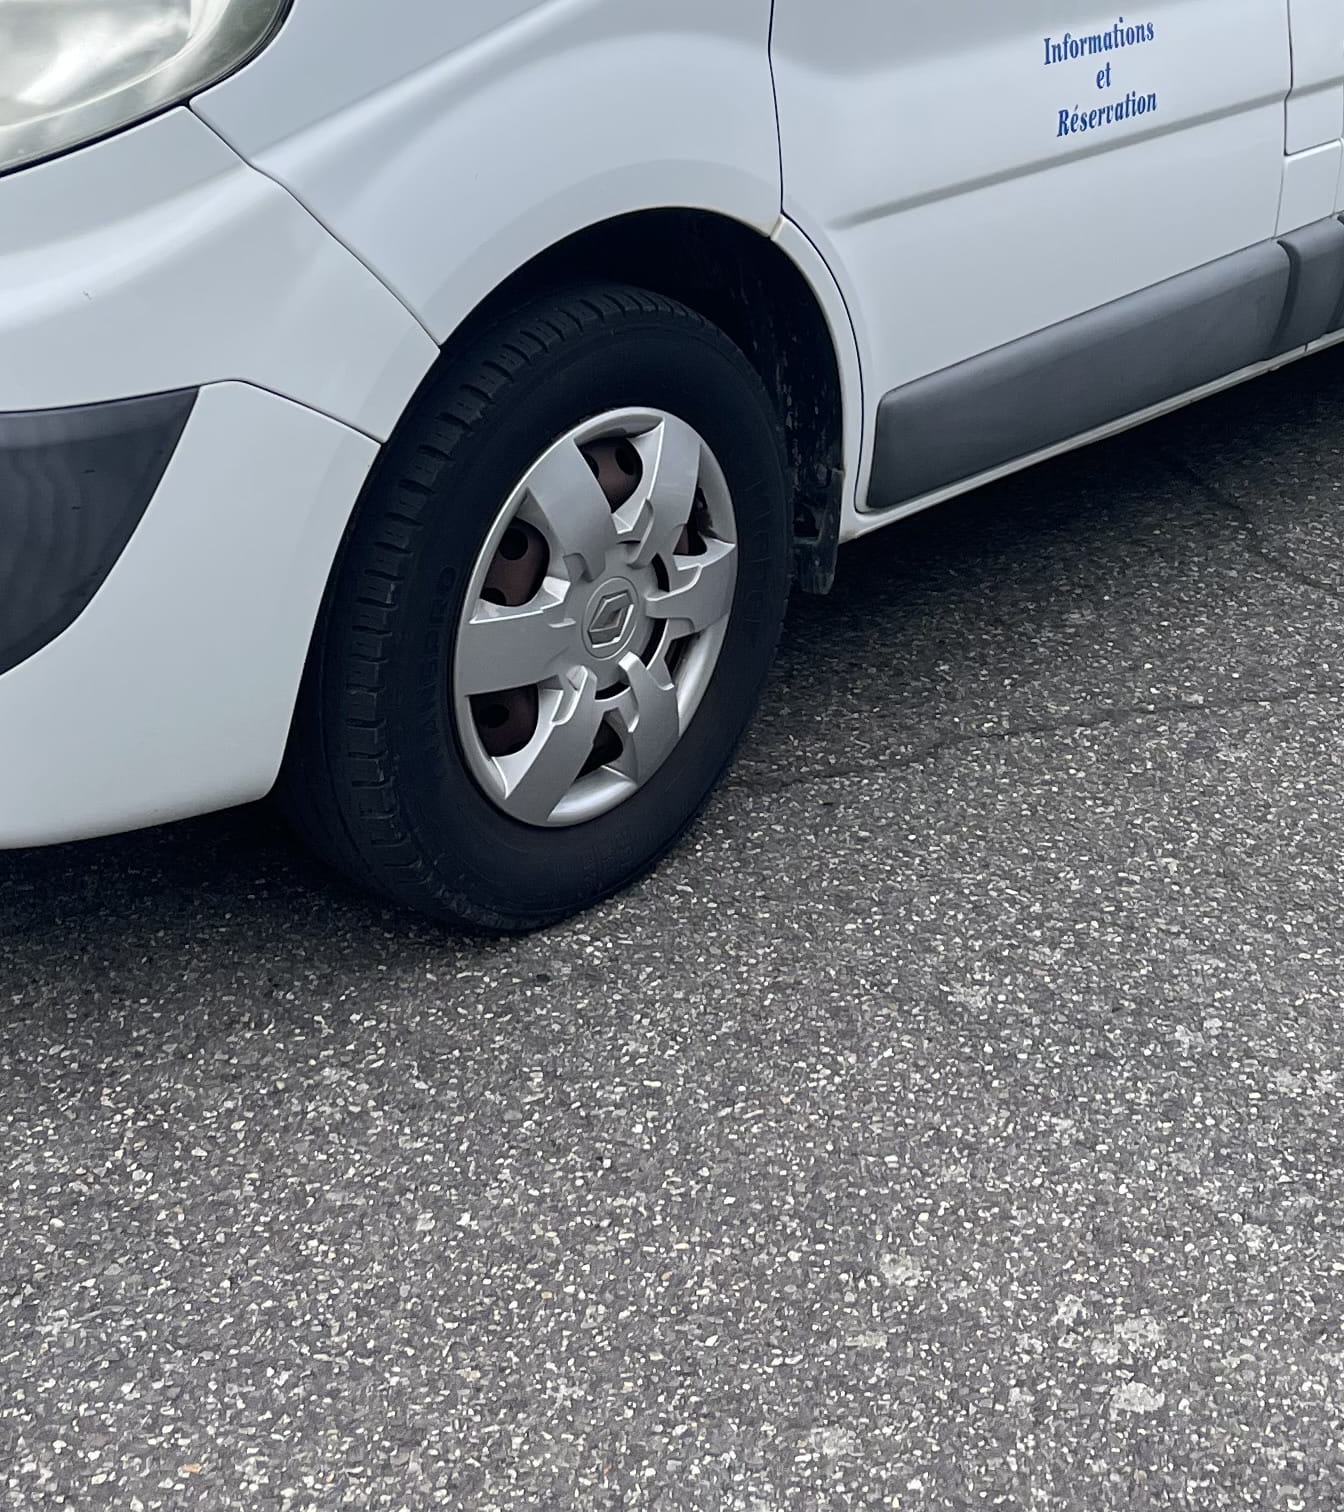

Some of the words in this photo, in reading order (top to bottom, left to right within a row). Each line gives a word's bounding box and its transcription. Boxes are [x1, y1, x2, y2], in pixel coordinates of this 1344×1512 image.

[1043, 16, 1155, 65] Informations
[1096, 61, 1111, 90] et
[1056, 90, 1157, 138] Réservation
